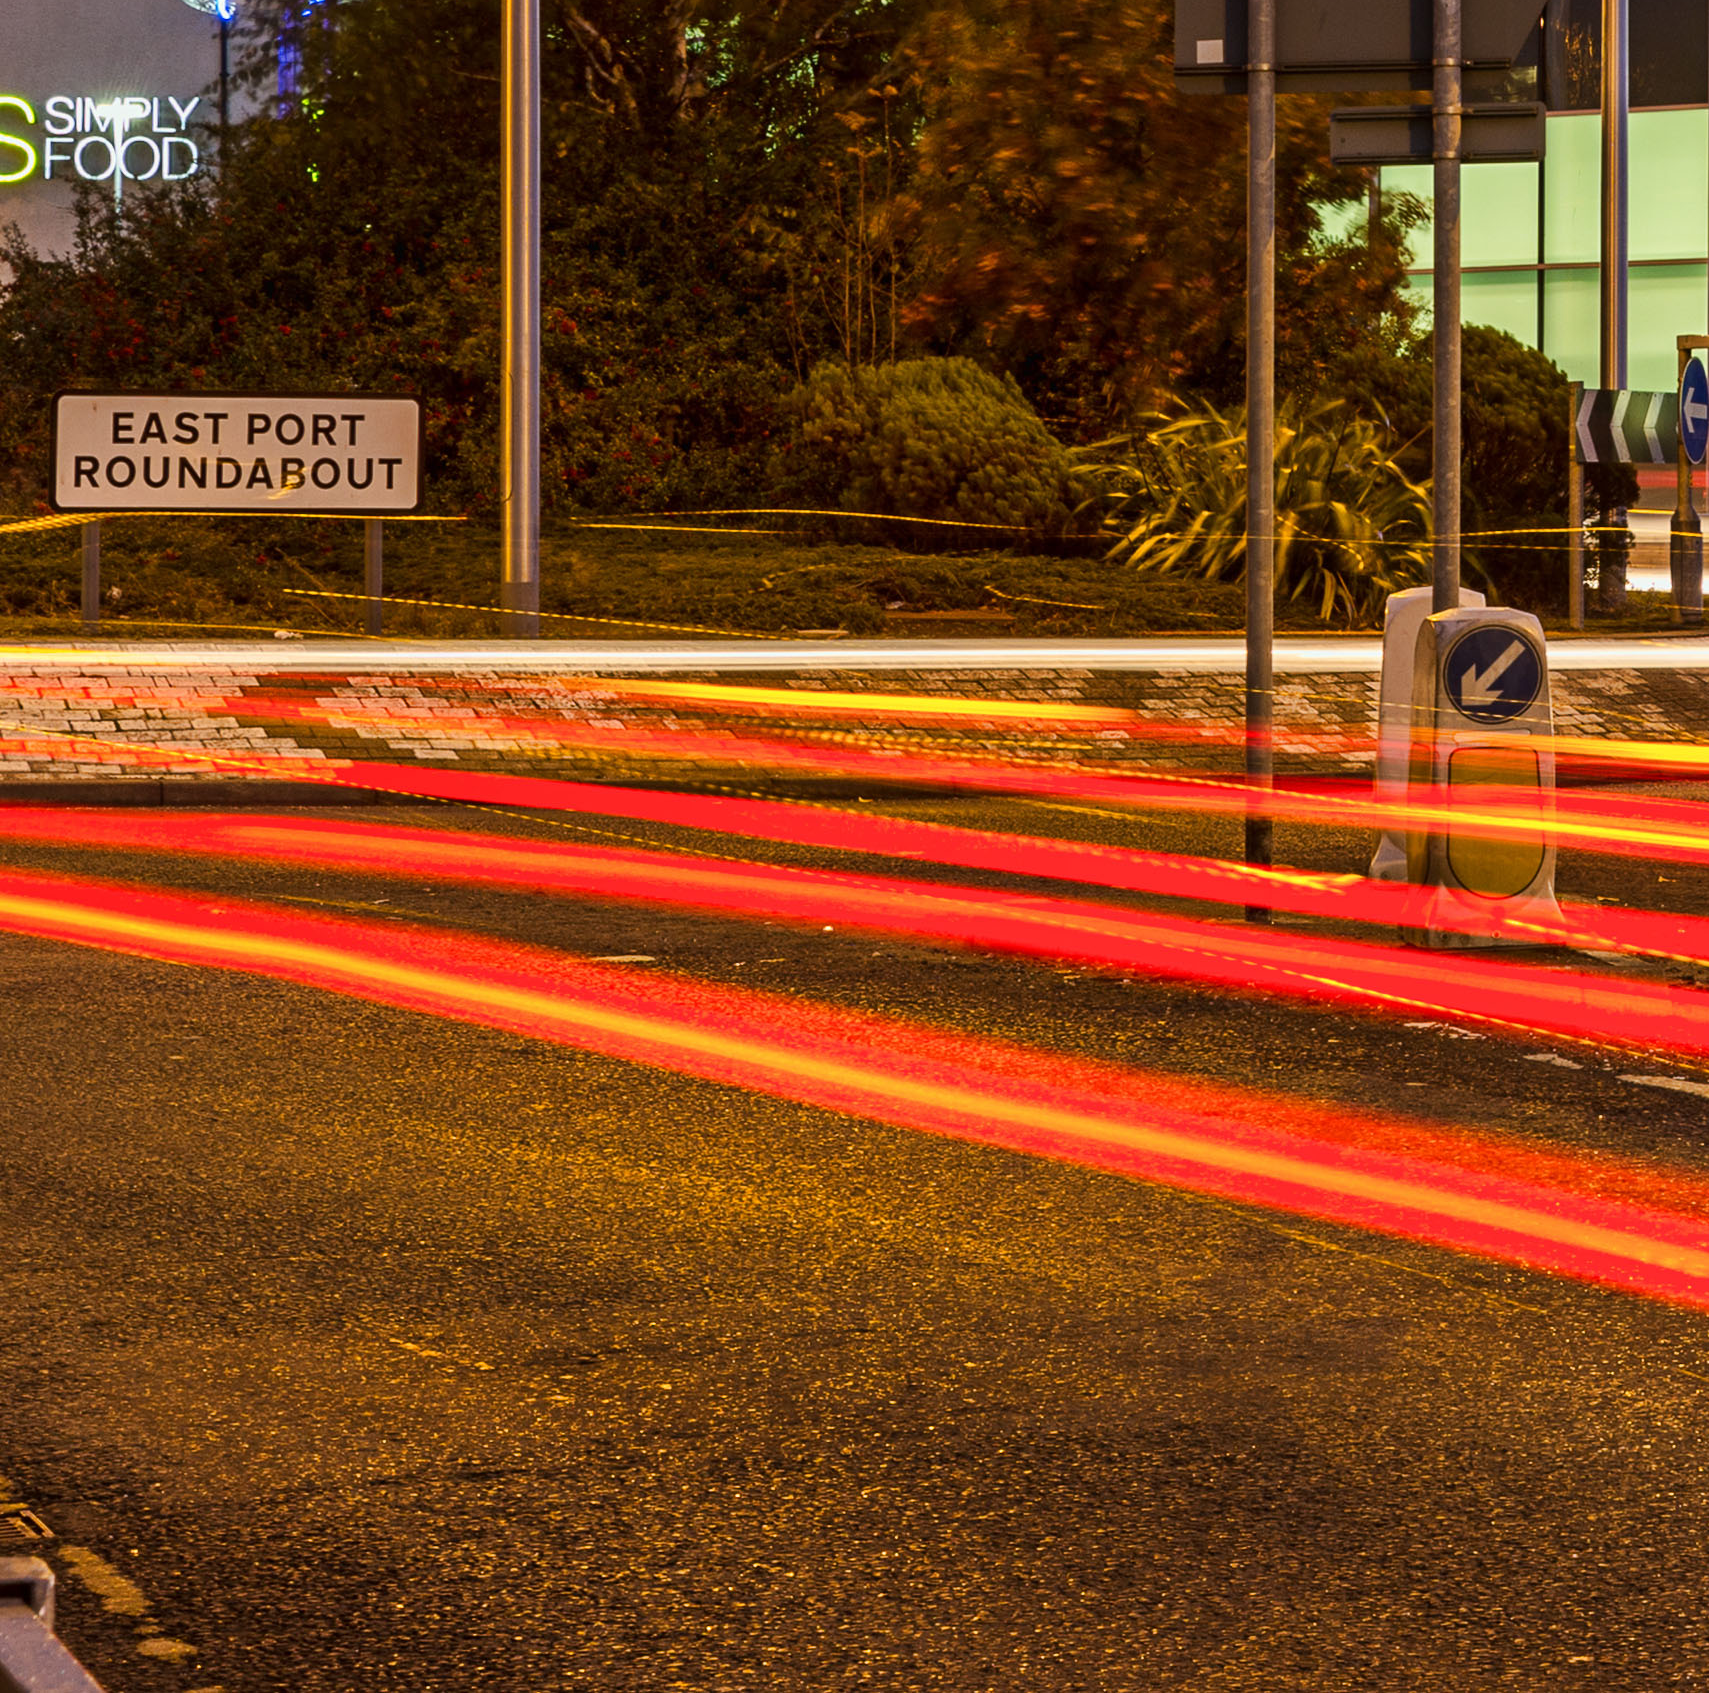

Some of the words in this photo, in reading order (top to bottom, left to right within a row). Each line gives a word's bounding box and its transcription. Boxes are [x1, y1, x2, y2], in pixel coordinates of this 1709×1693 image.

[44, 137, 199, 181] FOOD
[112, 411, 229, 445] EAST
[247, 413, 366, 447] PORT
[74, 455, 403, 490] ROUNDABOUT
